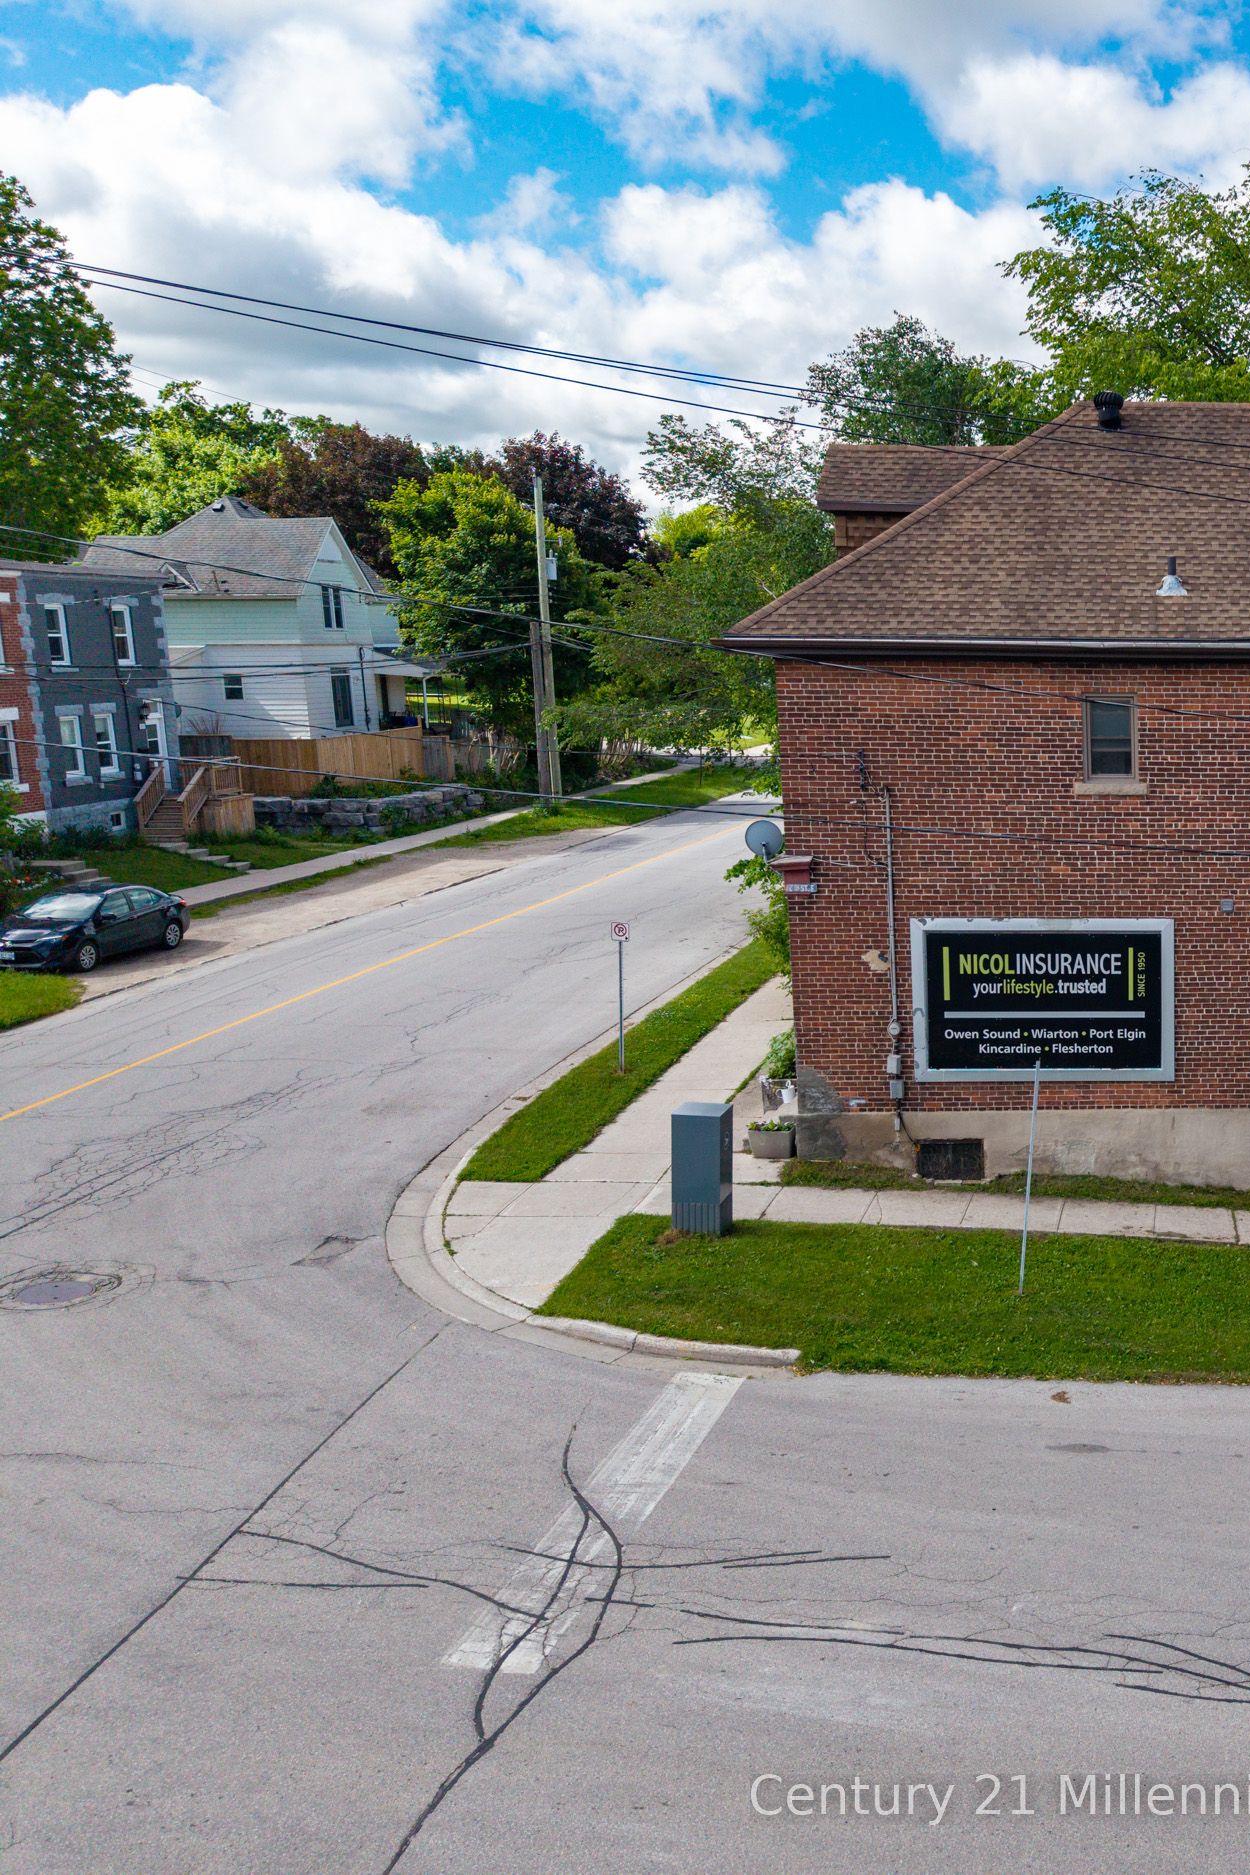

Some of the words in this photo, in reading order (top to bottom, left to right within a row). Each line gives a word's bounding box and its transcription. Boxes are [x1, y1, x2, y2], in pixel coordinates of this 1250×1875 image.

[1137, 952, 1146, 971] 1950
[1137, 973, 1146, 997] SINCE
[944, 1029, 979, 1039] Owen
[983, 1028, 1021, 1039] Sound
[1031, 1028, 1079, 1039] Wiarton
[1089, 1028, 1114, 1039] Port
[1117, 1028, 1146, 1041] Elgin
[979, 1043, 1042, 1054] Kincardine
[1052, 1043, 1114, 1054] Flesherton
